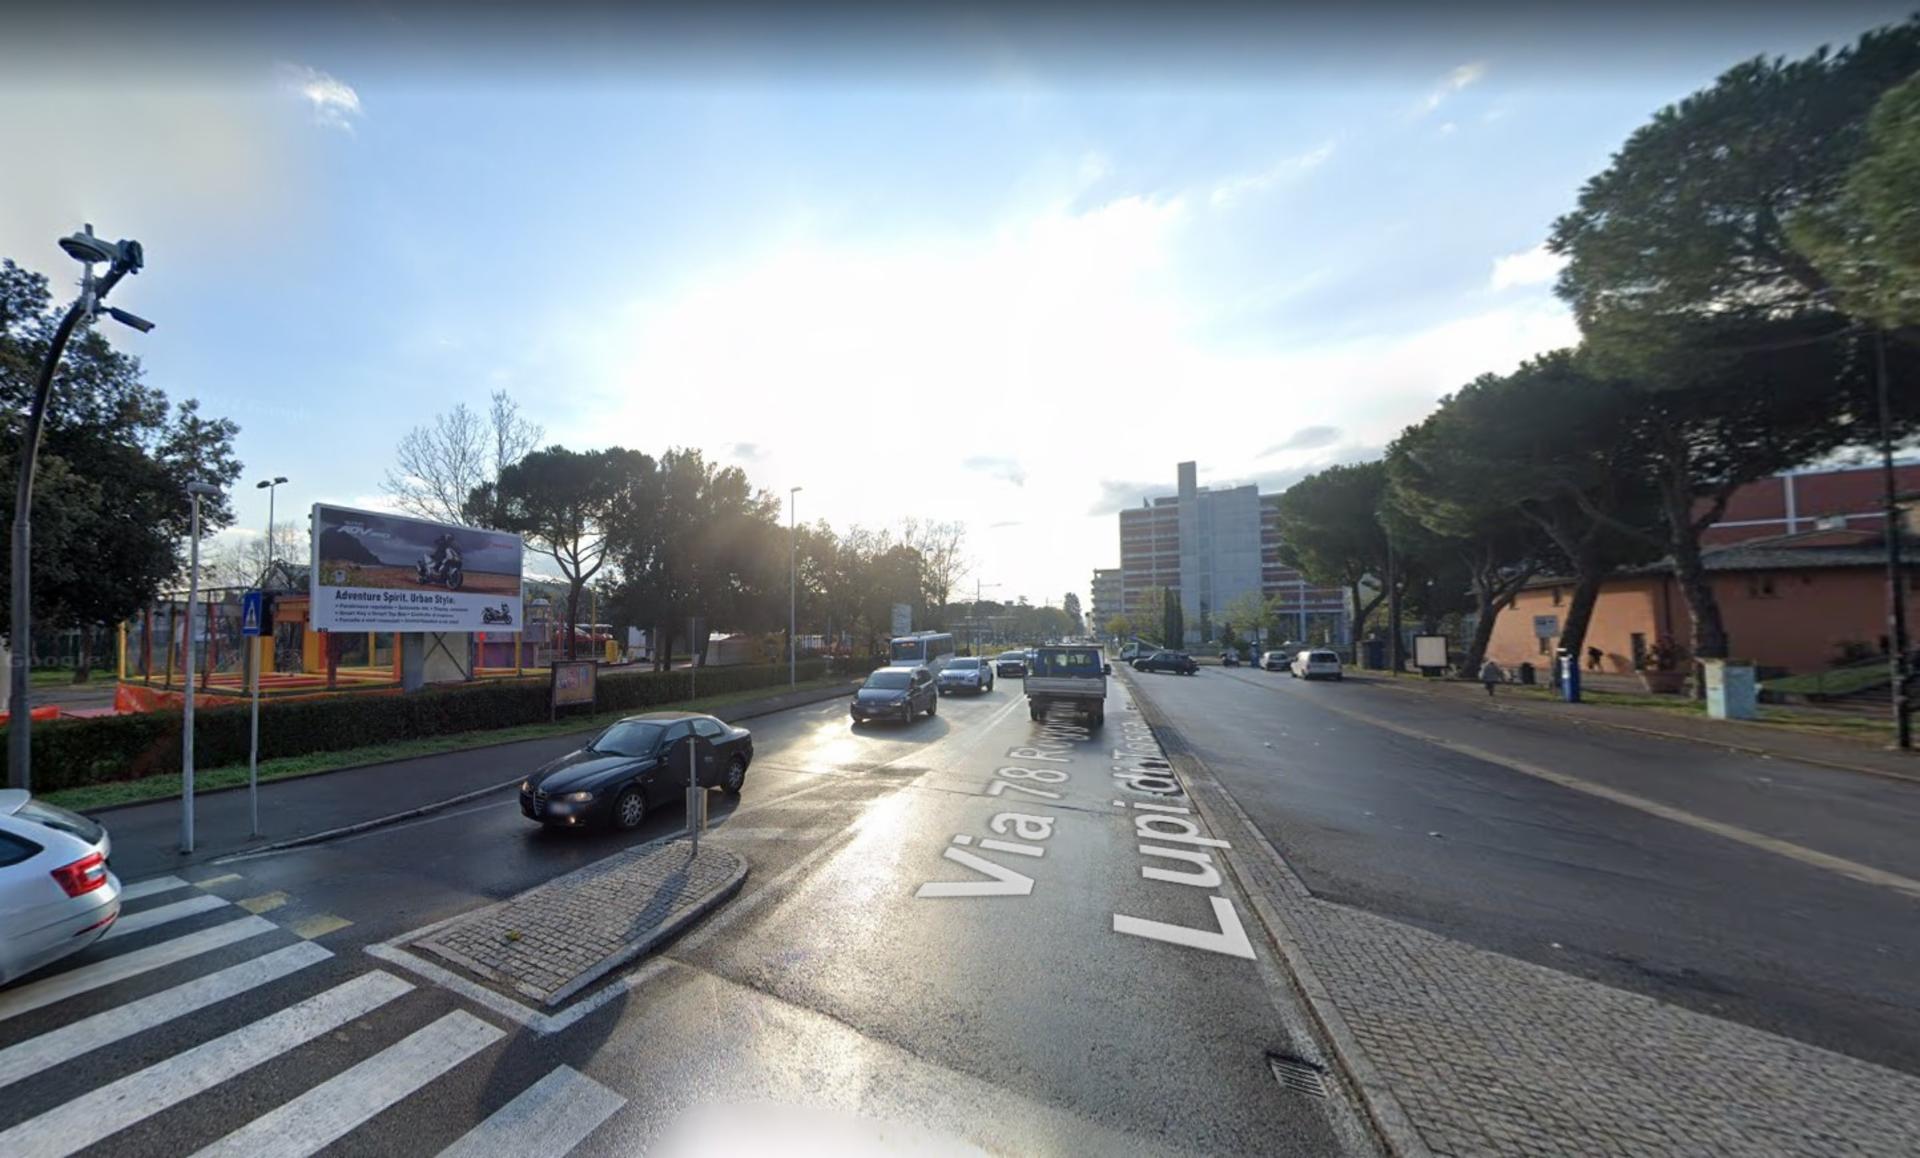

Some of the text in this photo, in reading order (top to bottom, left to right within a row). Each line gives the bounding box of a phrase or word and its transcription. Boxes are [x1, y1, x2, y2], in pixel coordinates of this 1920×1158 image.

[335, 589, 456, 606] Adventure Spirit. Urban Style.
